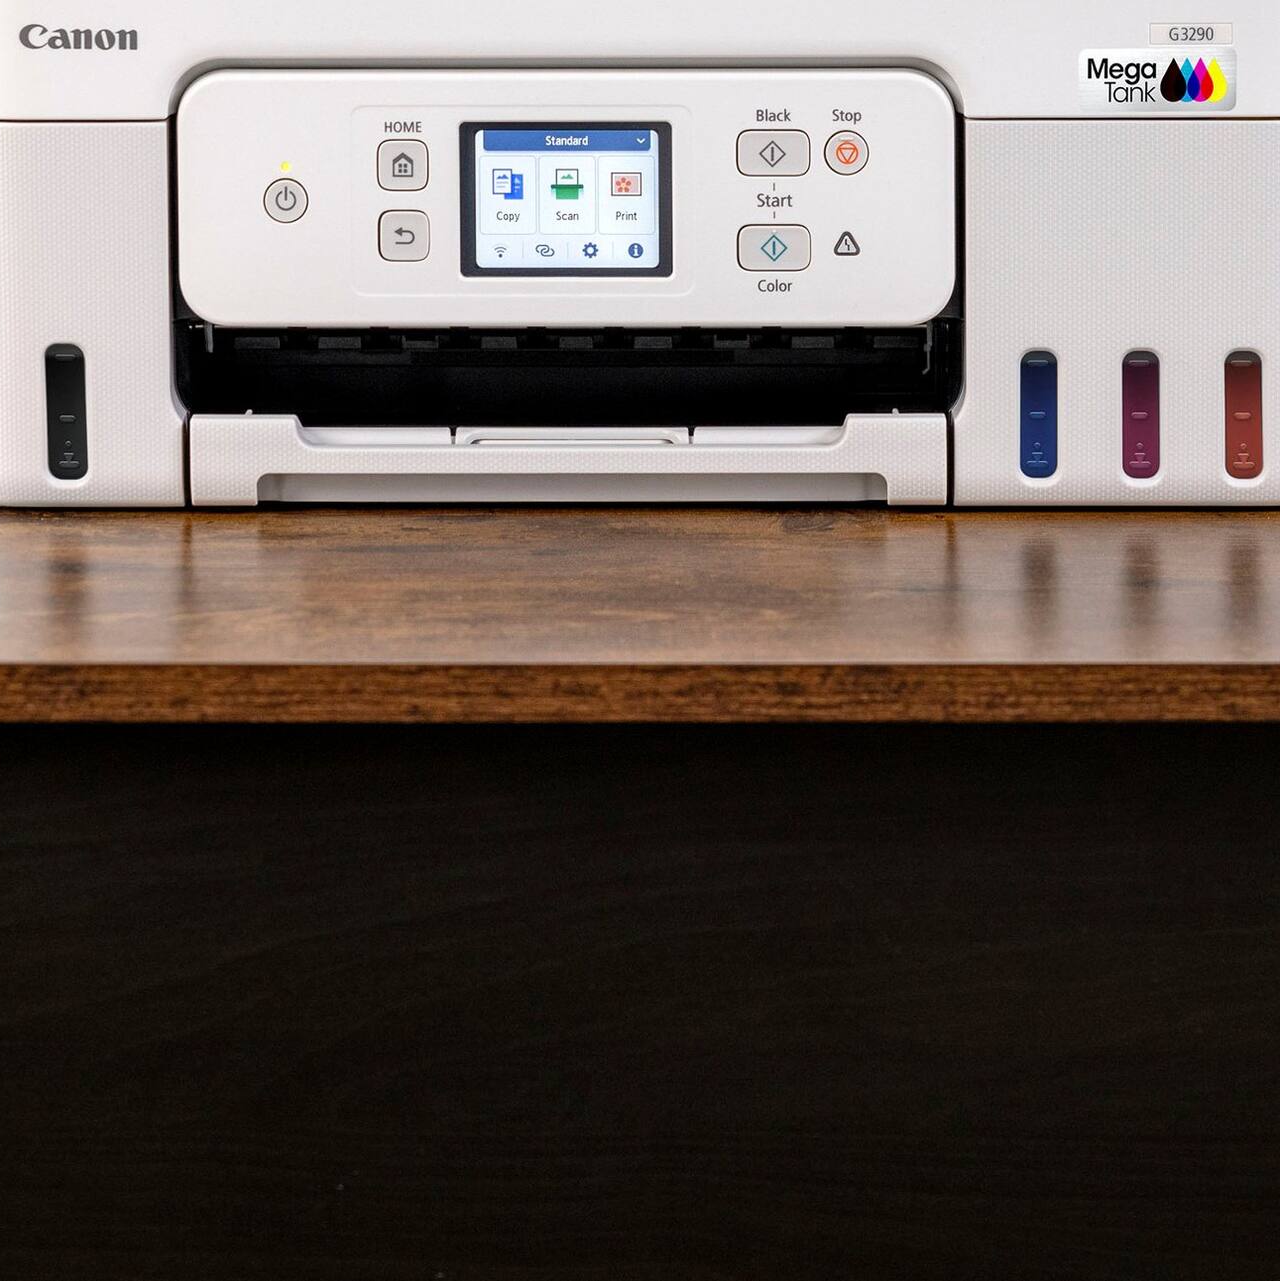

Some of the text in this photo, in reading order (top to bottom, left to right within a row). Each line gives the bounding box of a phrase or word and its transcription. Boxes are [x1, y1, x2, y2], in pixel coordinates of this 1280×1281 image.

[19, 23, 139, 50] Canon
[1168, 27, 1214, 41] G3290
[1087, 57, 1157, 85] Mega
[1104, 81, 1156, 103] Tank
[756, 109, 791, 122] Black
[832, 109, 862, 124] Stop
[384, 121, 422, 133] HOME
[545, 135, 589, 146] Standard
[757, 193, 793, 208] Start
[496, 211, 521, 222] Copy
[555, 211, 580, 221] Scan
[615, 211, 638, 221] Print
[757, 279, 793, 293] Color
